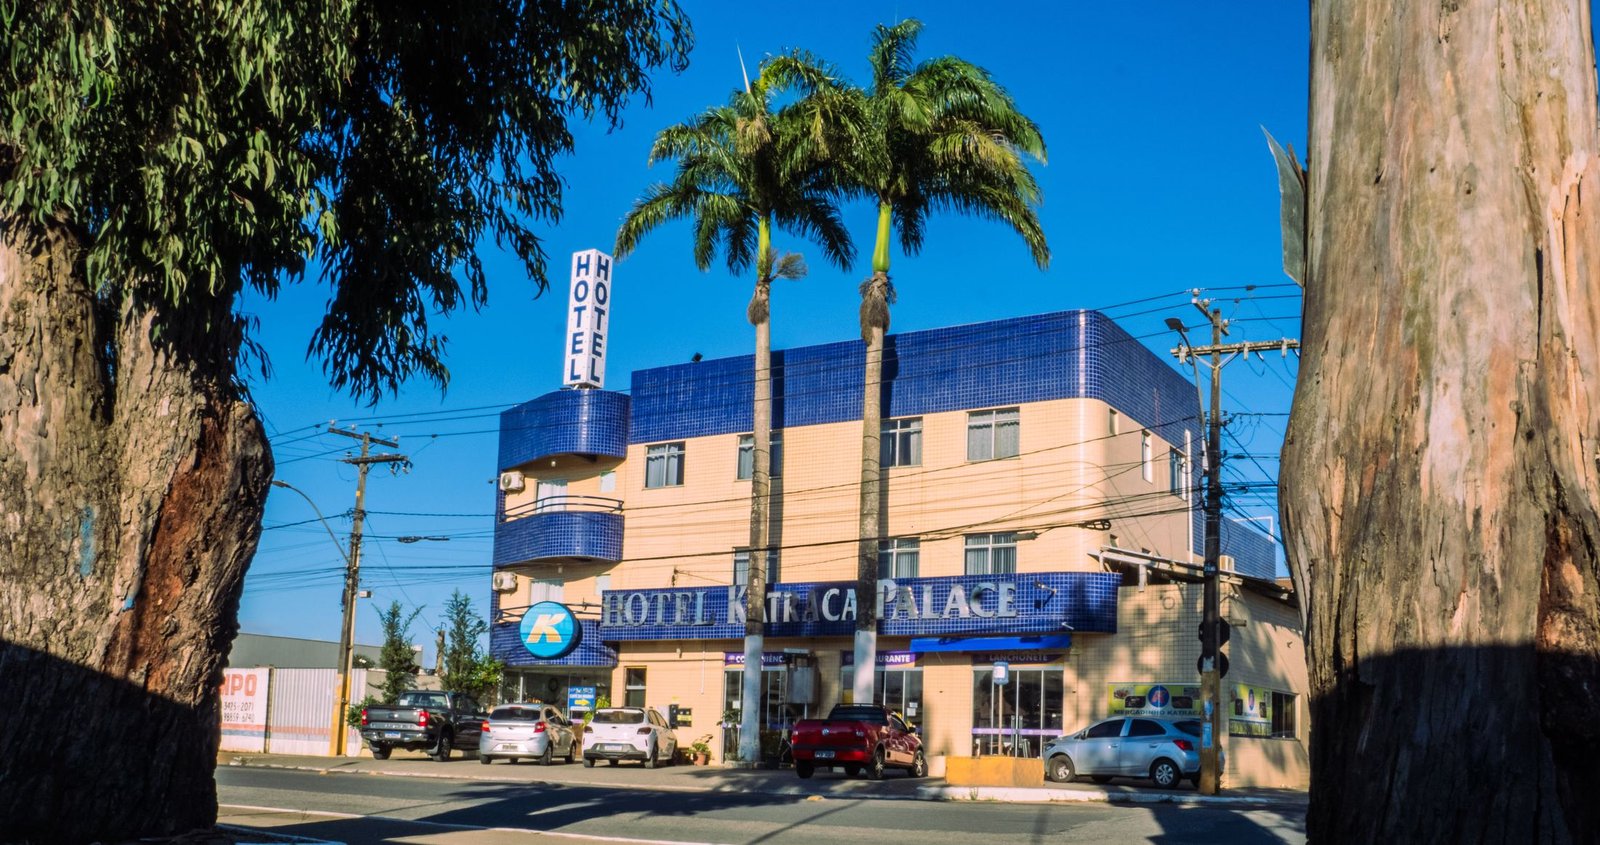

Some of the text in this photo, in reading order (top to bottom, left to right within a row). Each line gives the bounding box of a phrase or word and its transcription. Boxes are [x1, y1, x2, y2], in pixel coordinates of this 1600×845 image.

[570, 255, 591, 381] HOTEL
[590, 255, 609, 382] HOTEL
[603, 579, 1017, 627] HOTEL KTRACA PALACE
[527, 613, 566, 643] K
[989, 654, 1048, 662] LANCHONETE
